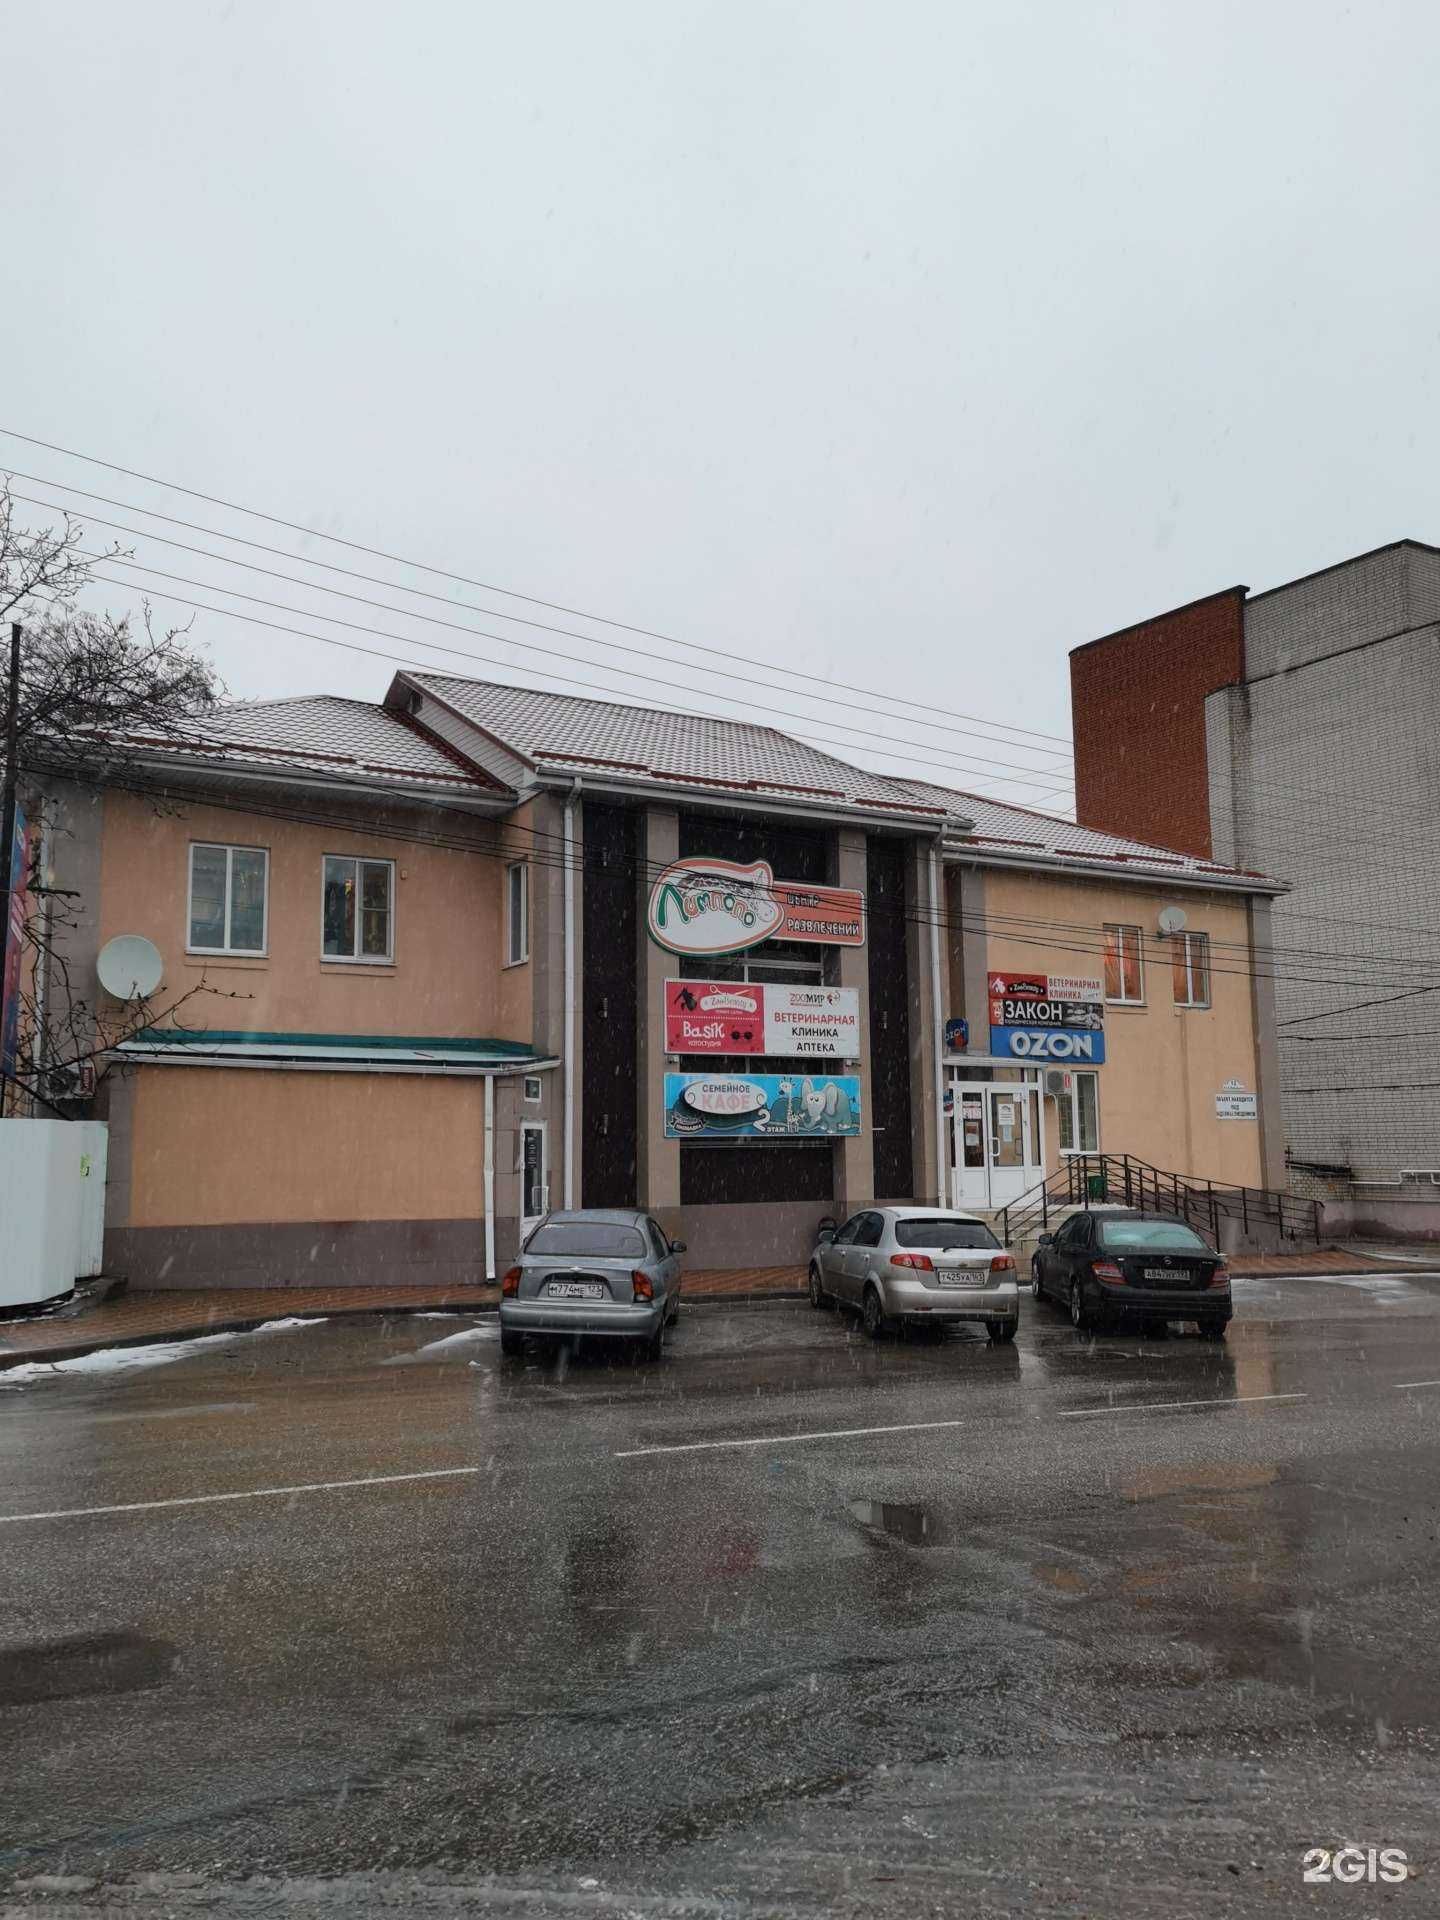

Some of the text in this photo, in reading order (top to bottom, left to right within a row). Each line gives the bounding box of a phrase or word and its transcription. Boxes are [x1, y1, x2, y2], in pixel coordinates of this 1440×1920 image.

[657, 882, 756, 929] Лимпопо
[787, 918, 860, 936] РАЗВЛЕЧЕНИЙ
[1048, 978, 1100, 989] ВЕТЕРИНАРНАЯ
[1049, 991, 1082, 999] КЛИНИКА
[1005, 1000, 1063, 1020] ЗАКОН
[774, 1012, 855, 1025] ВЕТЕРИНАРНАЯ
[792, 1027, 839, 1037] КЛИНИКА
[797, 1042, 835, 1052] АПТЕКА
[1009, 1031, 1093, 1057] OZON
[702, 1082, 750, 1093] СЕМЕЙНОЕ
[703, 1094, 750, 1110] КАФЕ
[753, 1108, 771, 1132] 2
